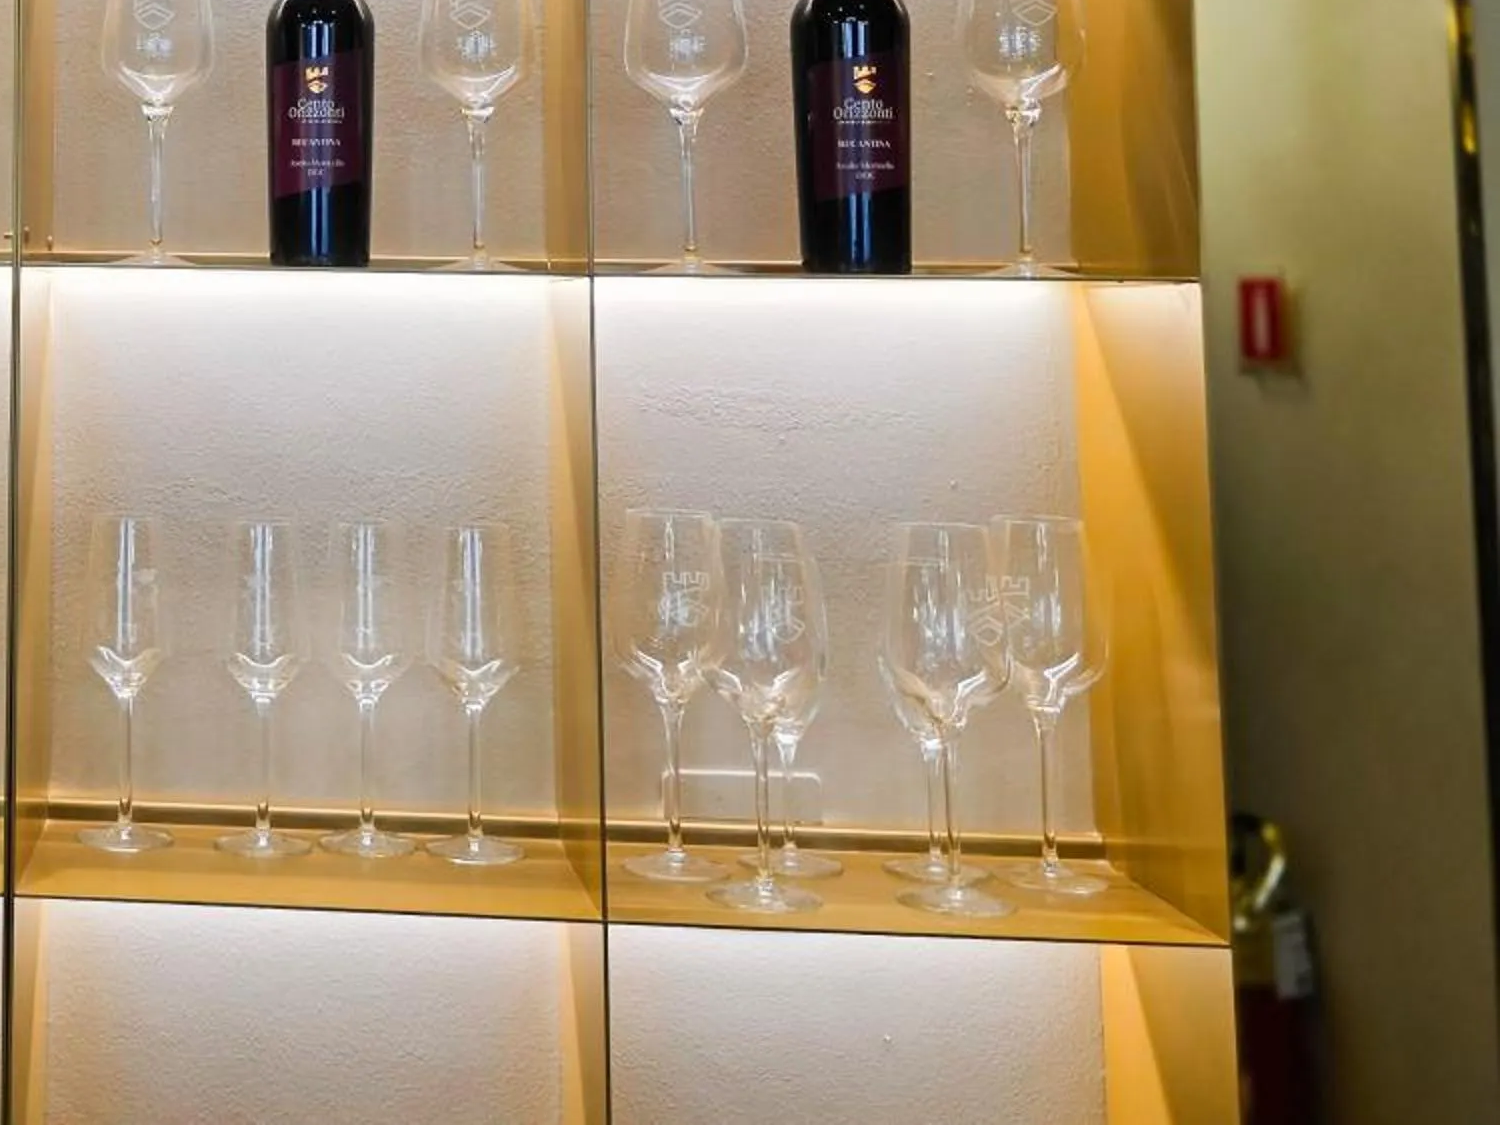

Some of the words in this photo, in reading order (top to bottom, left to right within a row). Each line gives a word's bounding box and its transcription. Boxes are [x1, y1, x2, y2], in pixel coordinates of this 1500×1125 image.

[297, 97, 334, 110] Cento
[843, 97, 884, 111] Cento
[833, 106, 894, 120] Orizzonti
